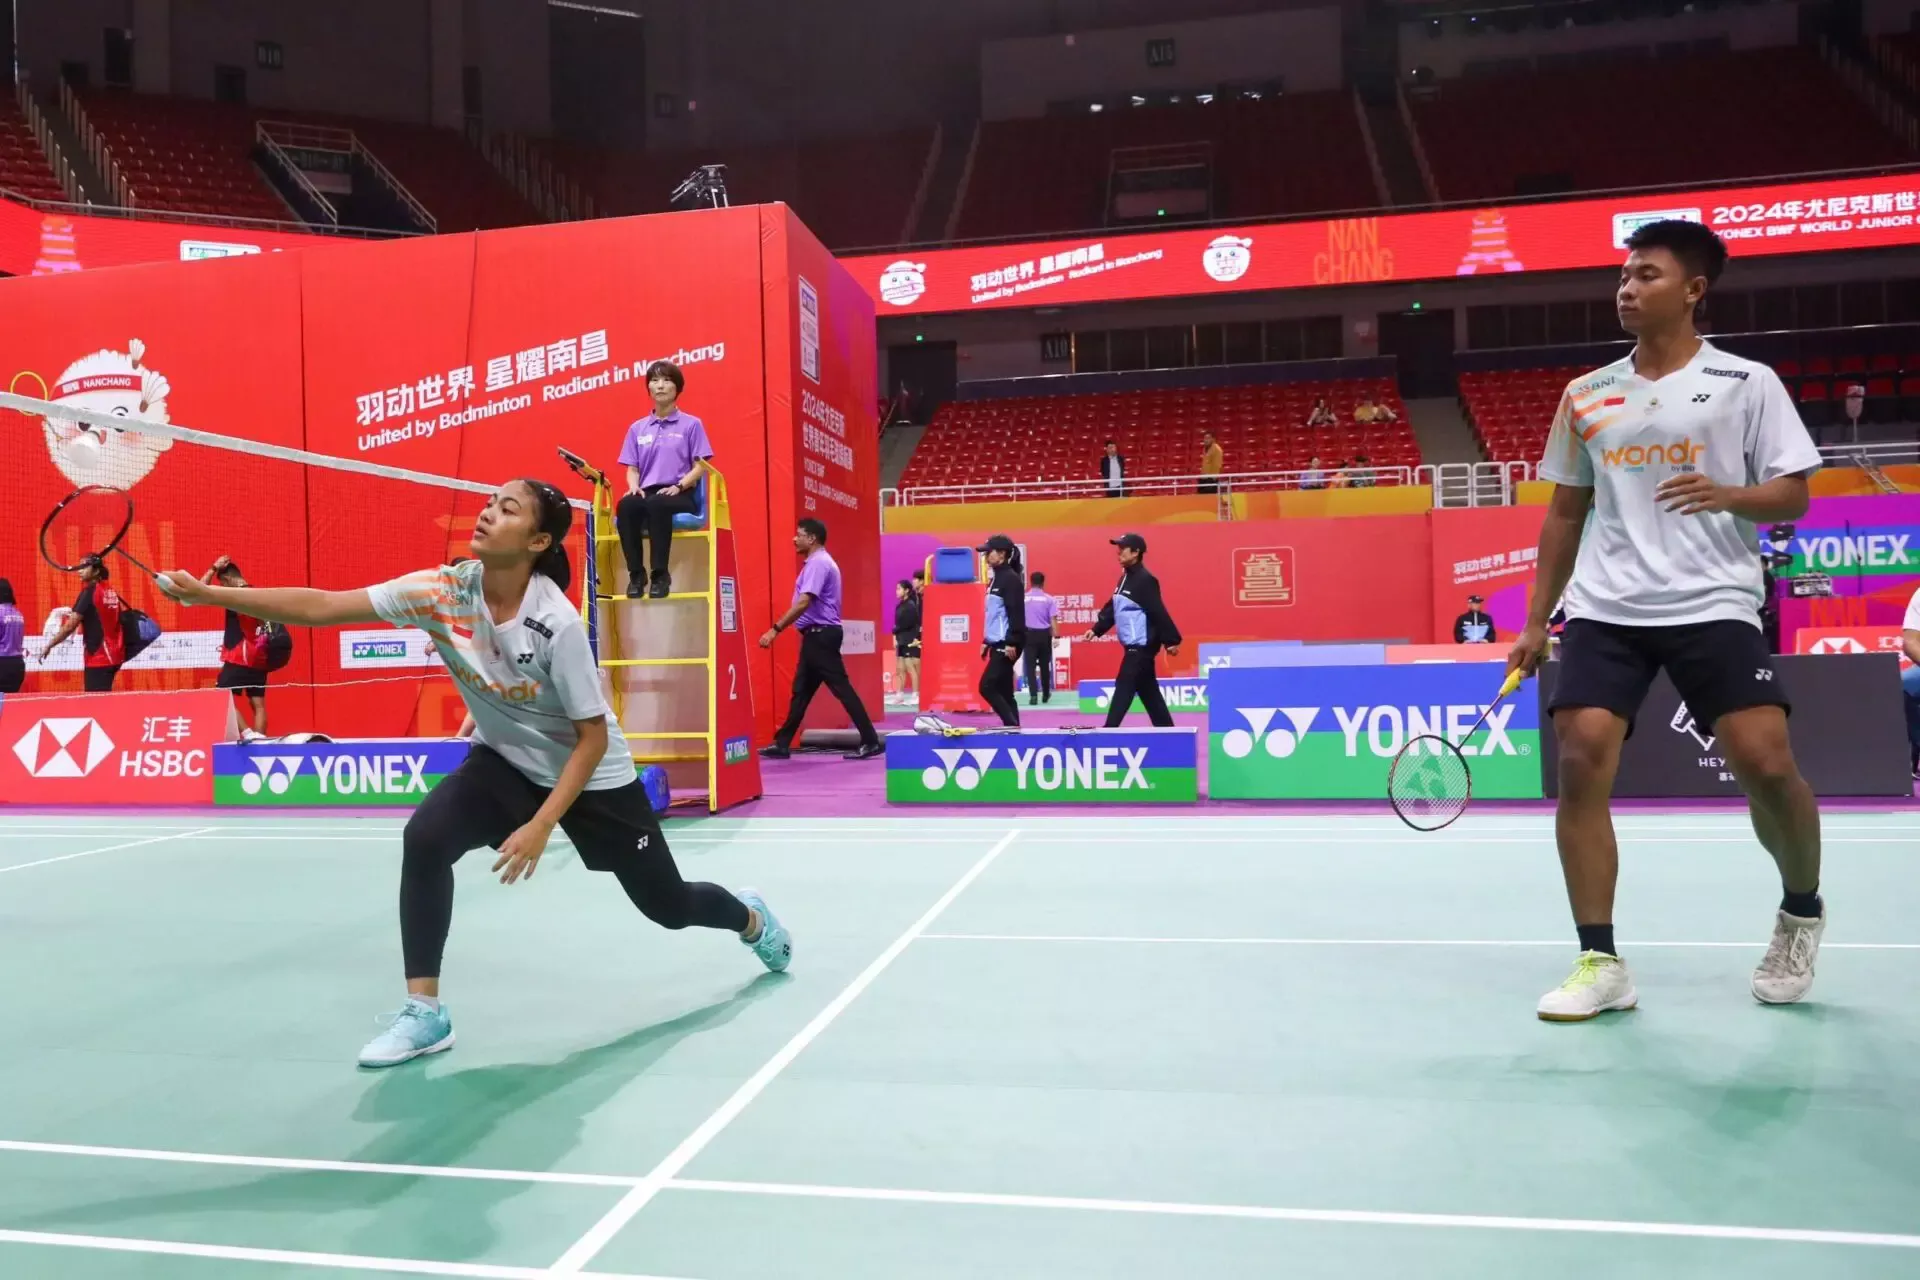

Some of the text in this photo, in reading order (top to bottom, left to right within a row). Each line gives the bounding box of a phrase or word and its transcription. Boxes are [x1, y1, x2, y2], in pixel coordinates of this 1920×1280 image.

[1712, 189, 1920, 224] 2024年尤尼克斯世
[1327, 217, 1379, 251] NAN
[1766, 224, 1797, 237] BWF
[1800, 220, 1853, 234] WORLD
[1856, 215, 1913, 229] JUNIOR
[1314, 247, 1394, 285] CHANG
[83, 377, 132, 389] NANCHANG
[356, 329, 609, 426] 羽动世界 星耀南昌
[1591, 375, 1616, 391] BNI
[358, 421, 412, 451] United
[415, 419, 437, 438] by
[439, 394, 532, 430] Badminton
[543, 371, 610, 402] Radiant
[613, 365, 630, 384] in
[1602, 436, 1706, 466] wondr
[1796, 534, 1911, 568] YONEX
[373, 643, 405, 655] YONEX
[727, 663, 738, 700] 2
[141, 716, 192, 743] 汇丰
[1332, 704, 1518, 757] YONEX
[119, 749, 206, 778] HSBC
[311, 754, 430, 794] YONEX
[1008, 746, 1150, 791] YONEX
